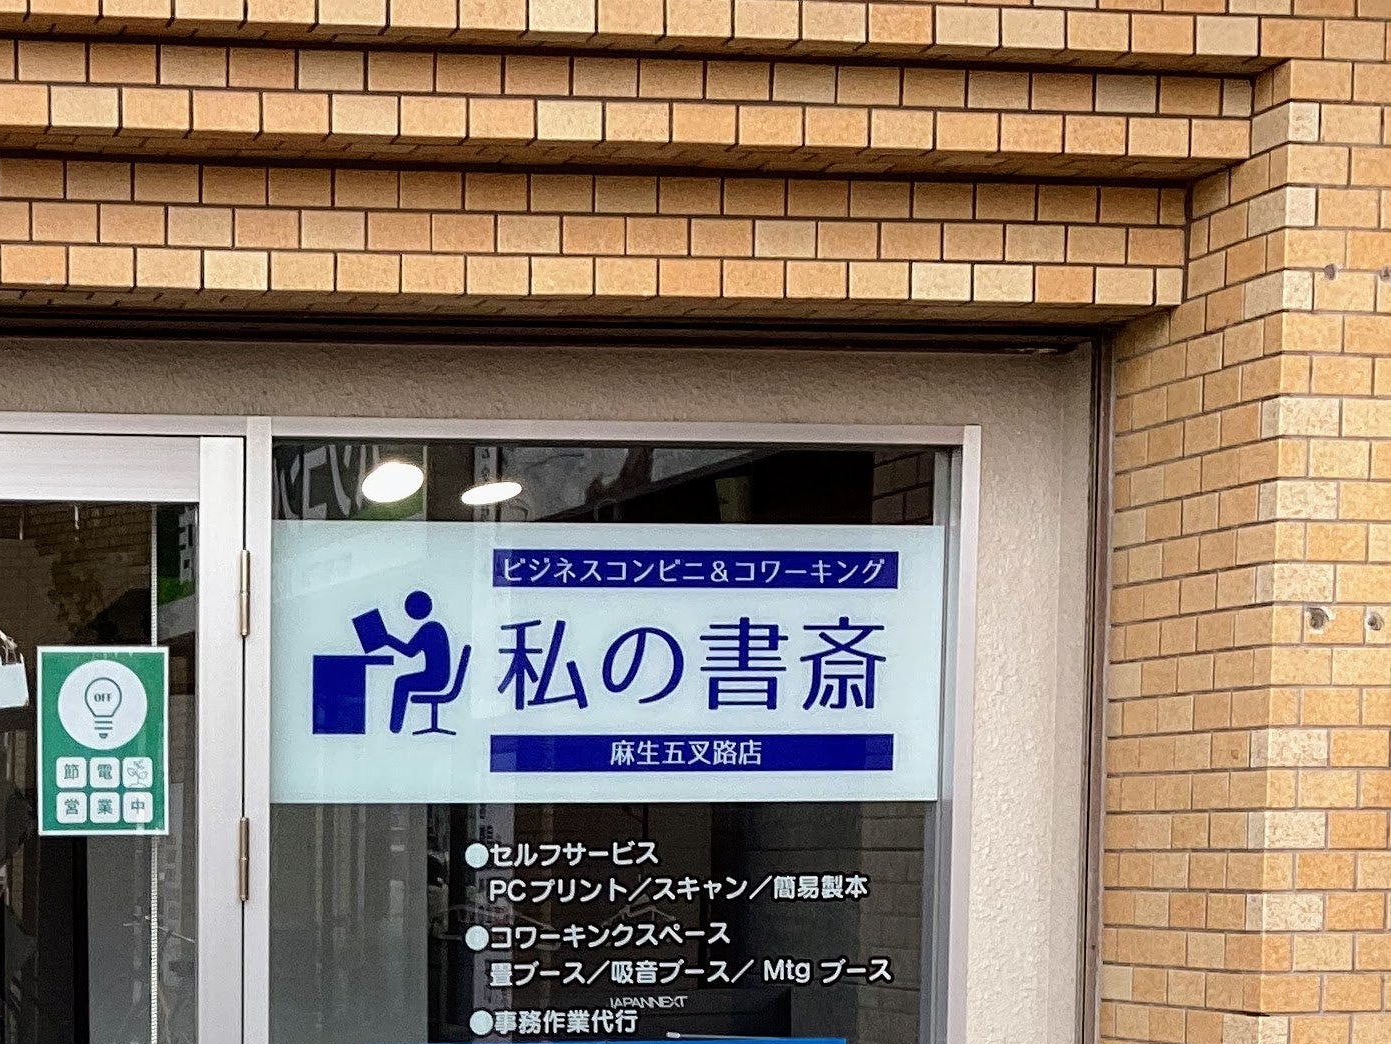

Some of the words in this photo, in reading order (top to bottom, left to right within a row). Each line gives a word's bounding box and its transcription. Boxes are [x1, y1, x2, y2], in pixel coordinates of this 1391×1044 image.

[503, 557, 886, 585] ビジネスコンビニ&コワーキング
[497, 616, 887, 712] 私の書斎
[94, 692, 113, 702] OFF
[610, 739, 762, 768] 麻生五叉路店
[490, 840, 659, 867] セルフサービス
[763, 958, 811, 984] Mtg
[820, 957, 892, 984] ブース
[608, 995, 689, 1010] JAPANNEXT
[494, 1009, 639, 1035] 事務作業代行
